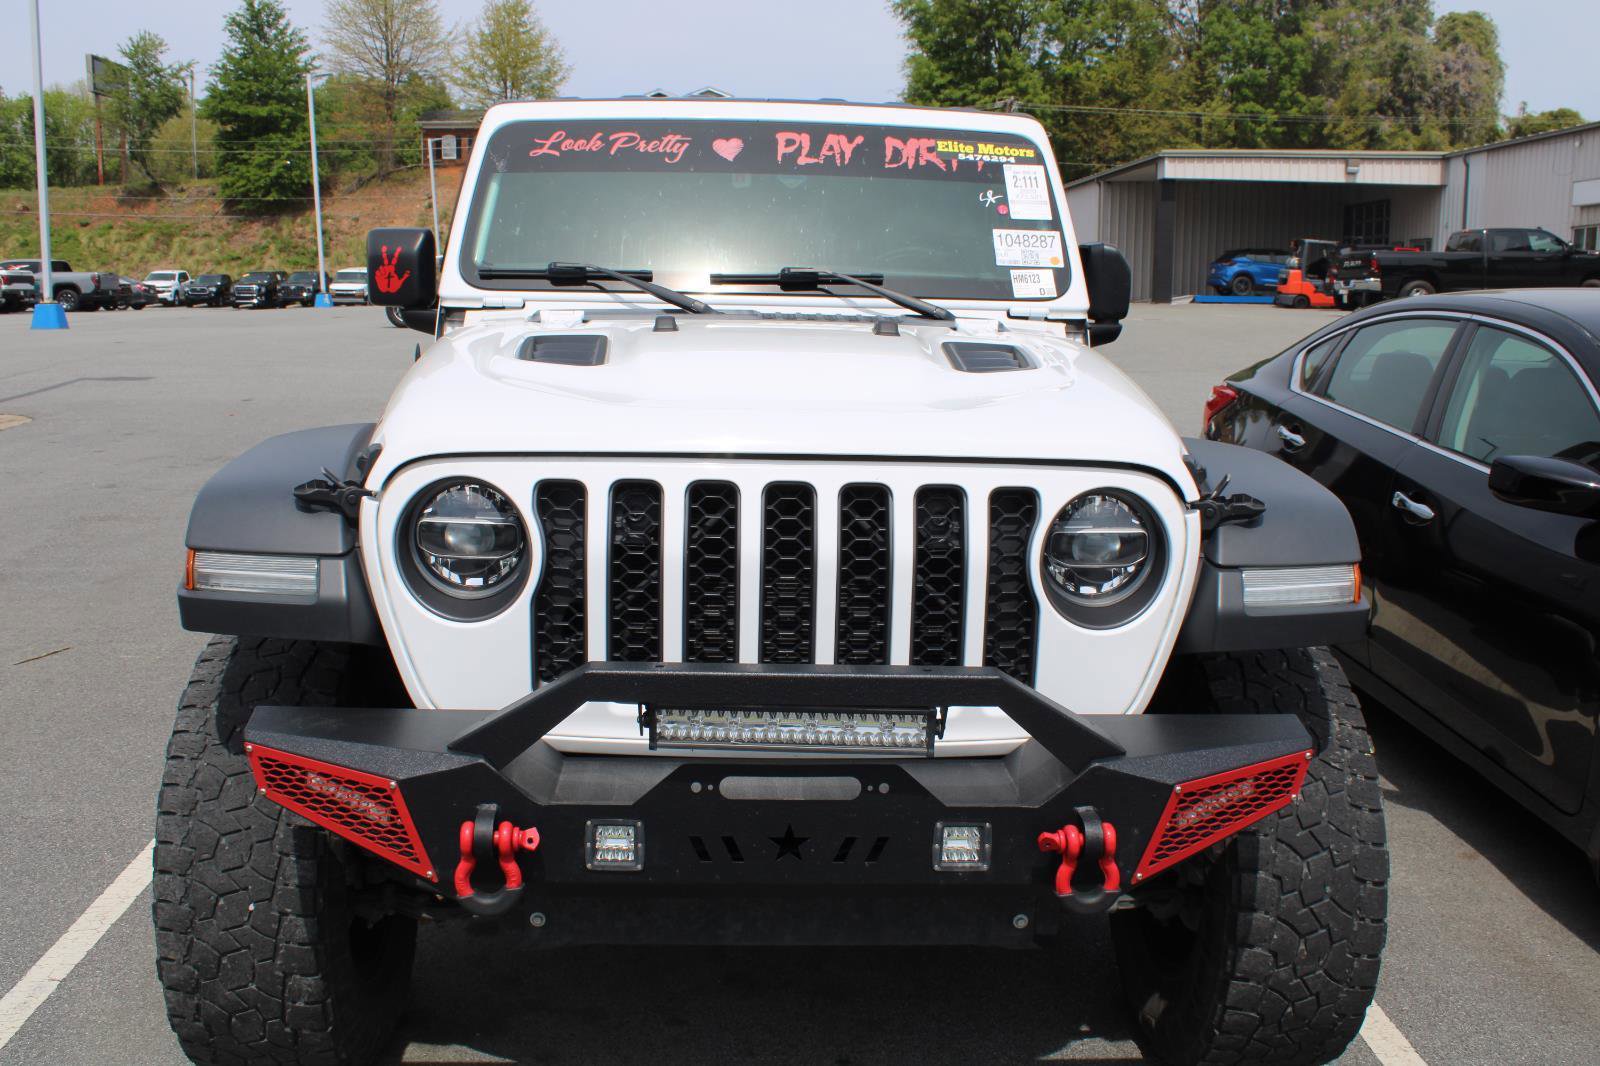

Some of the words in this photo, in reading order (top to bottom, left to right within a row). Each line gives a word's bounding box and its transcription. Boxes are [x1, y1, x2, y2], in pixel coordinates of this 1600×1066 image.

[529, 130, 605, 157] Look
[608, 131, 692, 164] Pretty
[775, 132, 864, 166] PLAY
[936, 140, 975, 154] Elite
[977, 143, 1035, 158] Motors
[996, 232, 1056, 249] 1048287
[1012, 273, 1041, 284] HM6123
